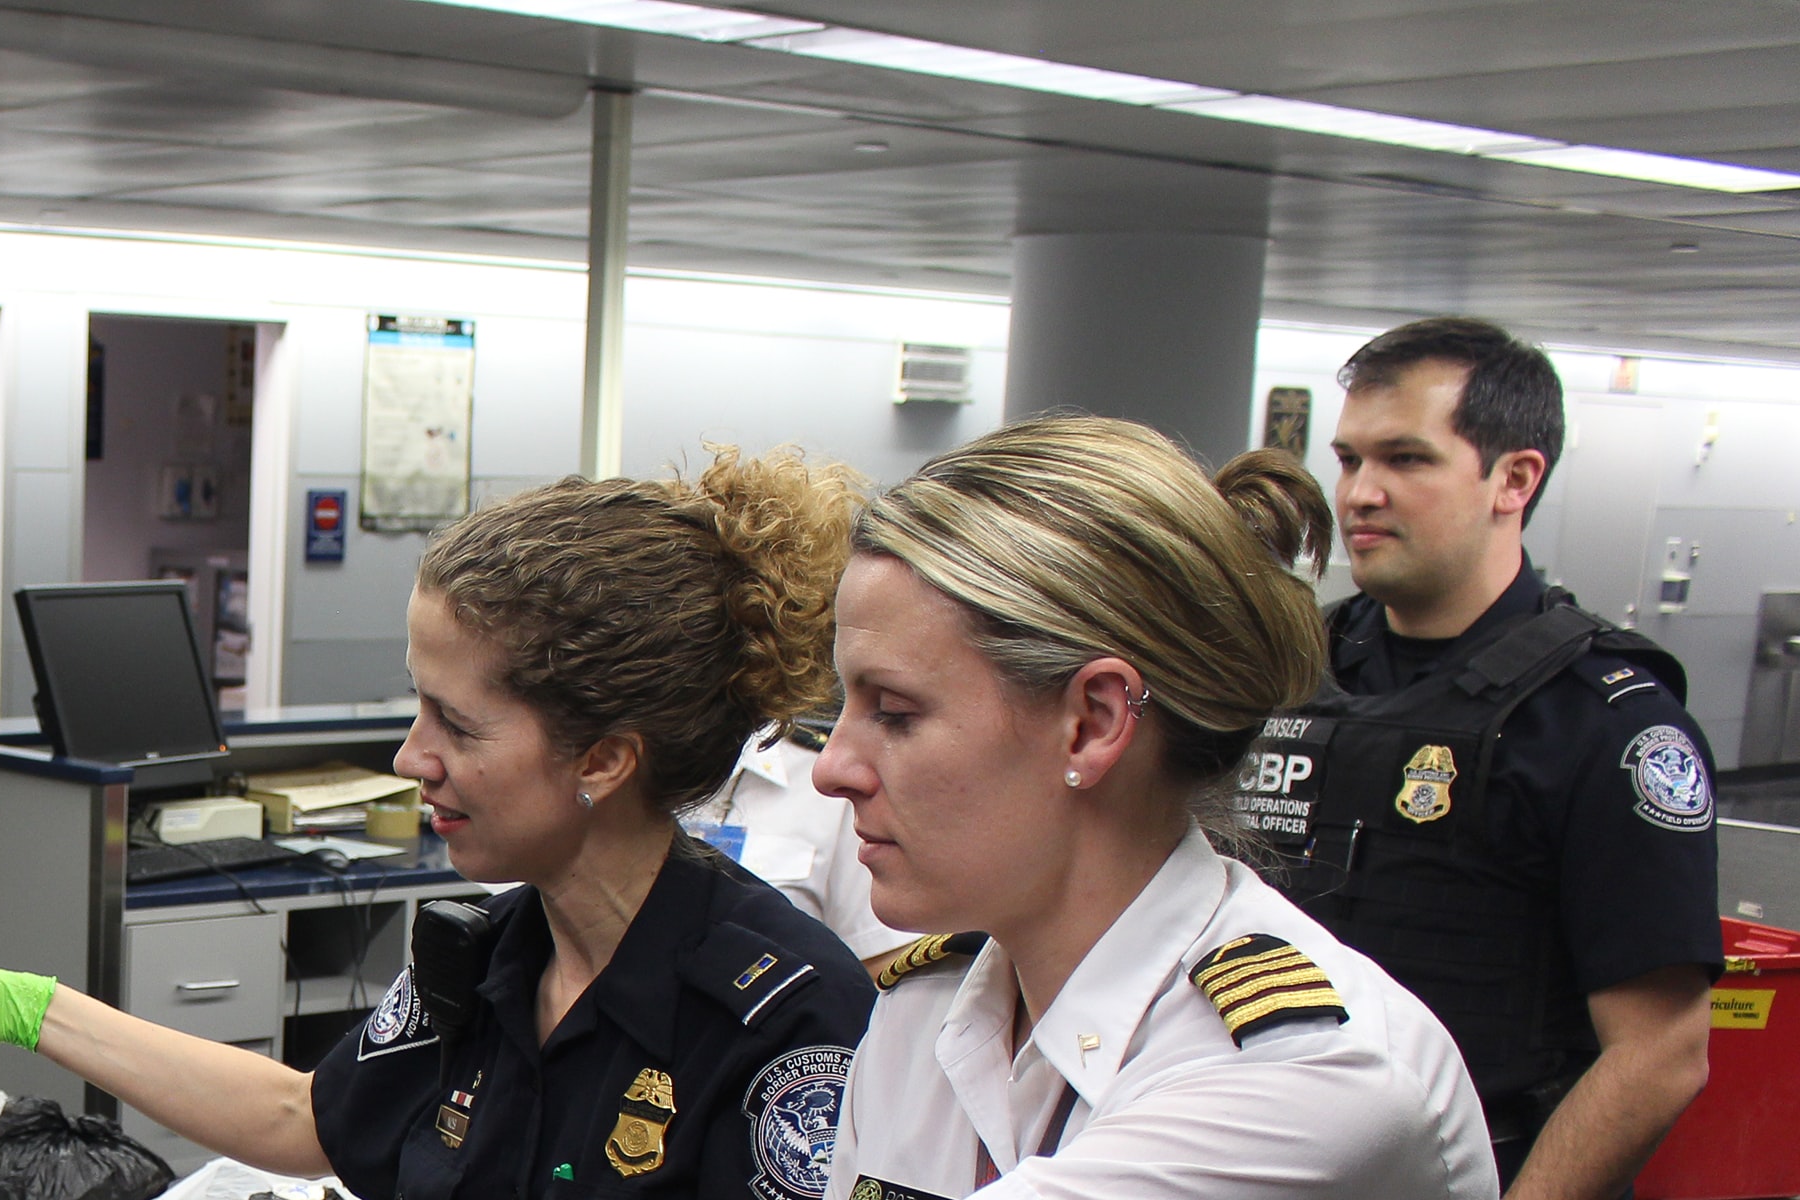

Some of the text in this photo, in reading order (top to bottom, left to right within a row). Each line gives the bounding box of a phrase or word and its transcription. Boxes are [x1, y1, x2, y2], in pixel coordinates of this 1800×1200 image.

[1250, 797, 1311, 817] OPERATIONS
[1262, 815, 1308, 835] OFFICER
[1660, 813, 1683, 826] FIELD
[764, 1065, 786, 1084] U.S.
[786, 1052, 842, 1070] CUSTOMS
[760, 1067, 801, 1102] BORDER
